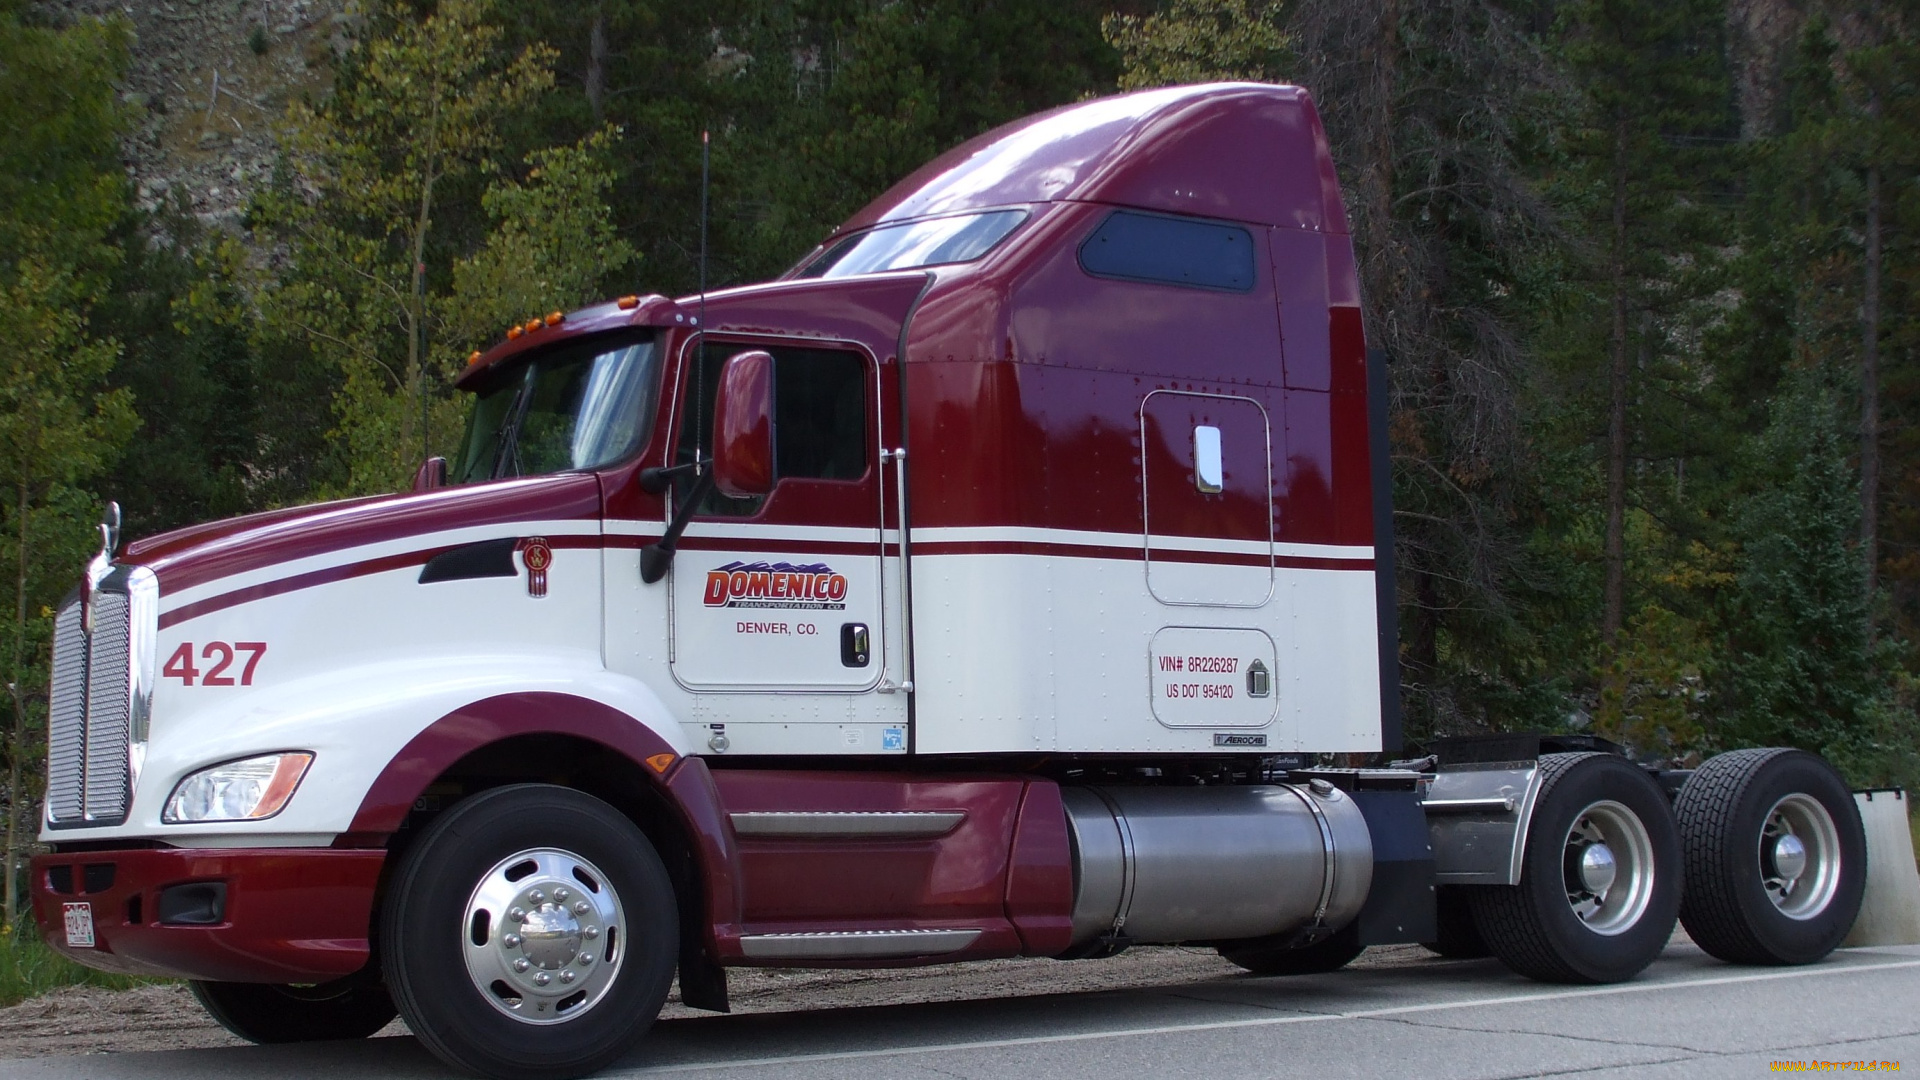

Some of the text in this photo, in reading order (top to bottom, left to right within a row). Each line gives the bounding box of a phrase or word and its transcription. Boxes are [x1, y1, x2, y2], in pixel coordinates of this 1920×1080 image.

[703, 571, 848, 607] DOMENICO
[734, 602, 824, 610] TRANSPORTATION
[736, 622, 819, 636] DENVER, CO.
[163, 641, 267, 686] 427
[1159, 656, 1239, 673] VIN# 8R226287
[1166, 683, 1234, 699] US DOT 954120
